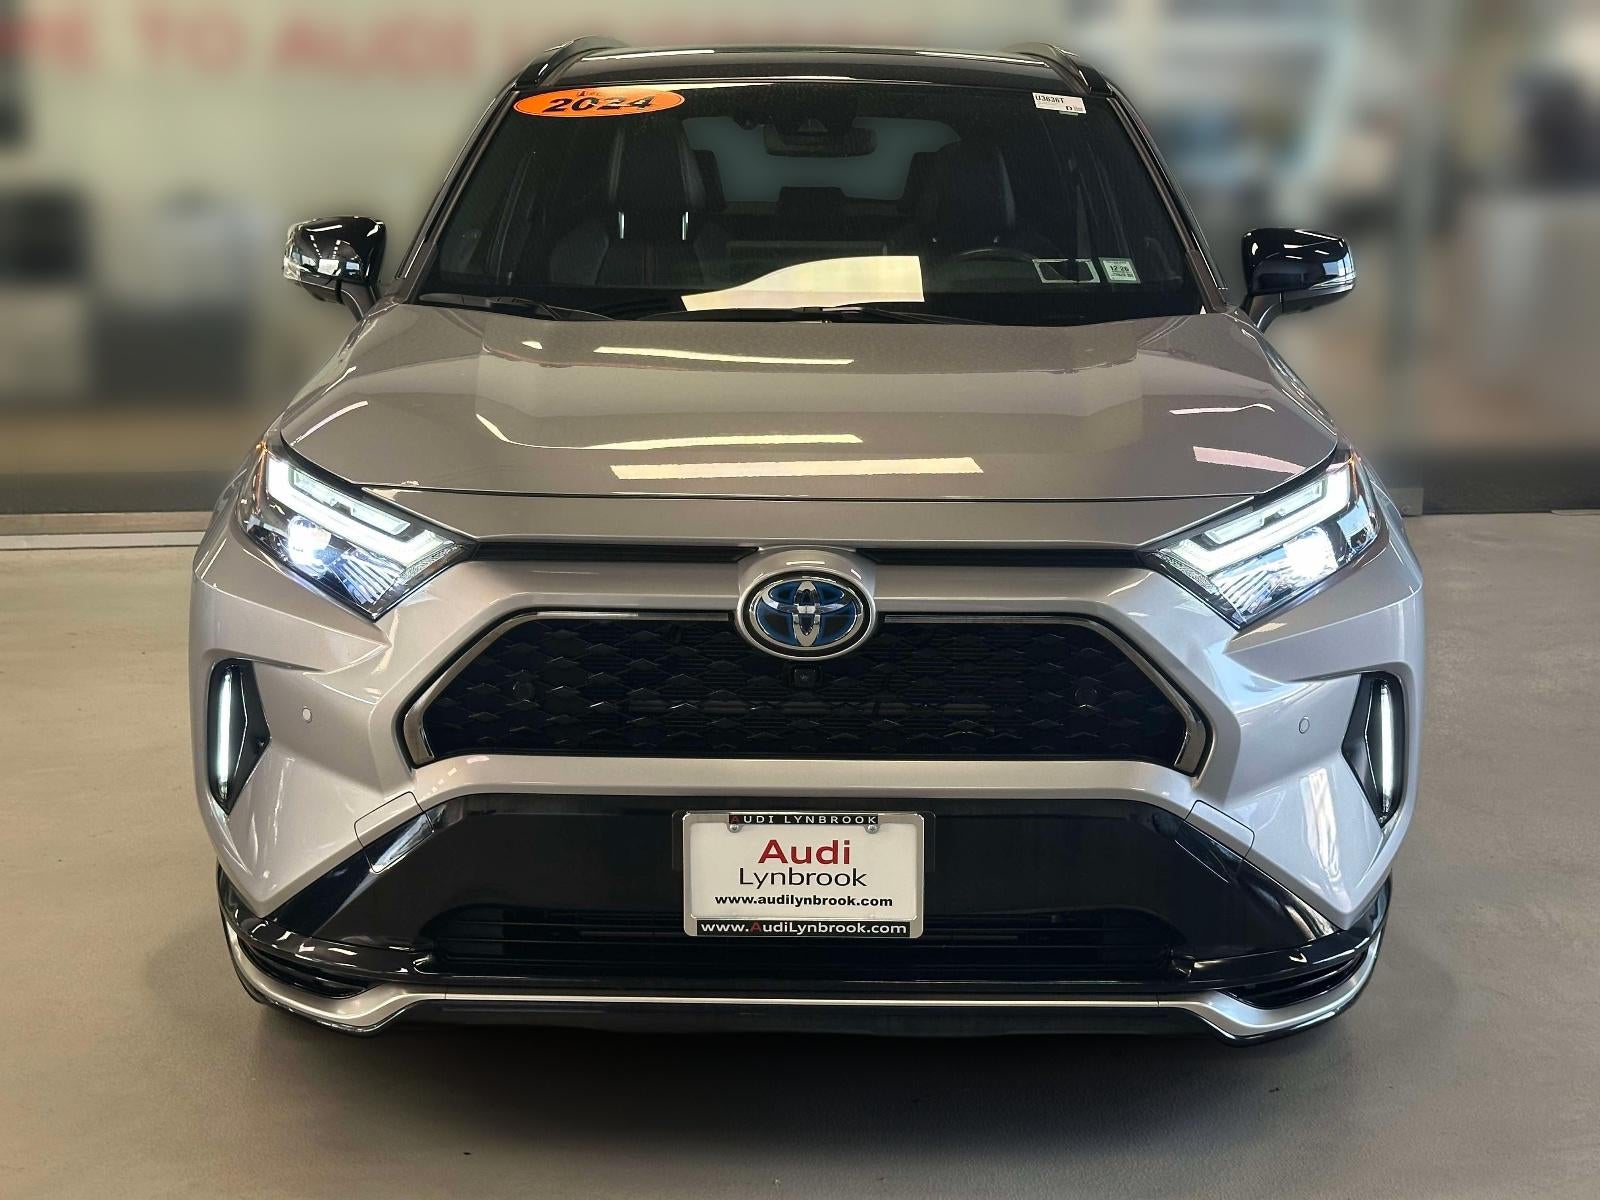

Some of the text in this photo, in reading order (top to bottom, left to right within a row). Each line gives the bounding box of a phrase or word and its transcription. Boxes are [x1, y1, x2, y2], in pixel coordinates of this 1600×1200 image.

[542, 95, 655, 113] 2024
[730, 815, 877, 824] AUDI LYNBROOK
[757, 838, 851, 865] Audi
[738, 867, 868, 890] Lynbrook
[714, 894, 893, 908] www.audilynbrook.com
[700, 921, 908, 935] www.AudiLynbrook.com
